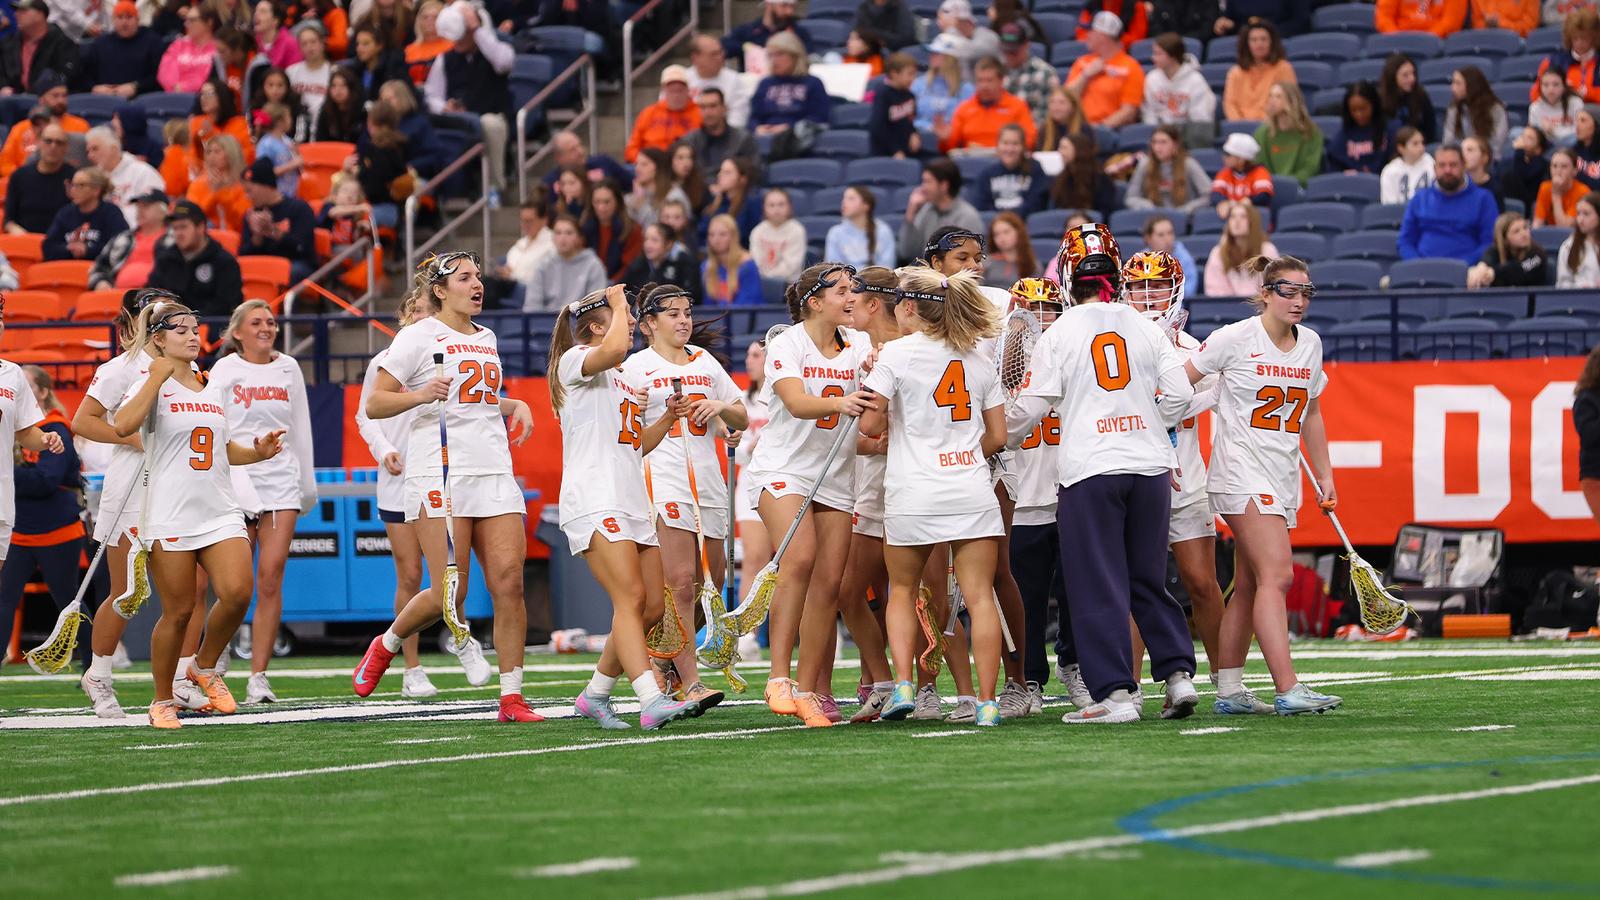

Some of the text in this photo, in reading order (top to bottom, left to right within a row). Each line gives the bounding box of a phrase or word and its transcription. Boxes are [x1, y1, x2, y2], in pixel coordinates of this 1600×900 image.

[458, 360, 501, 404] 29
[803, 367, 854, 380] SYRACUS
[1090, 331, 1132, 392] 0
[1256, 364, 1311, 380] SYRACUSE
[933, 360, 971, 422] 4
[1250, 385, 1309, 434] 27
[618, 398, 641, 451] 15
[189, 426, 213, 471] 9
[428, 490, 443, 509] S
[665, 502, 681, 520] S
[602, 517, 621, 534] S
